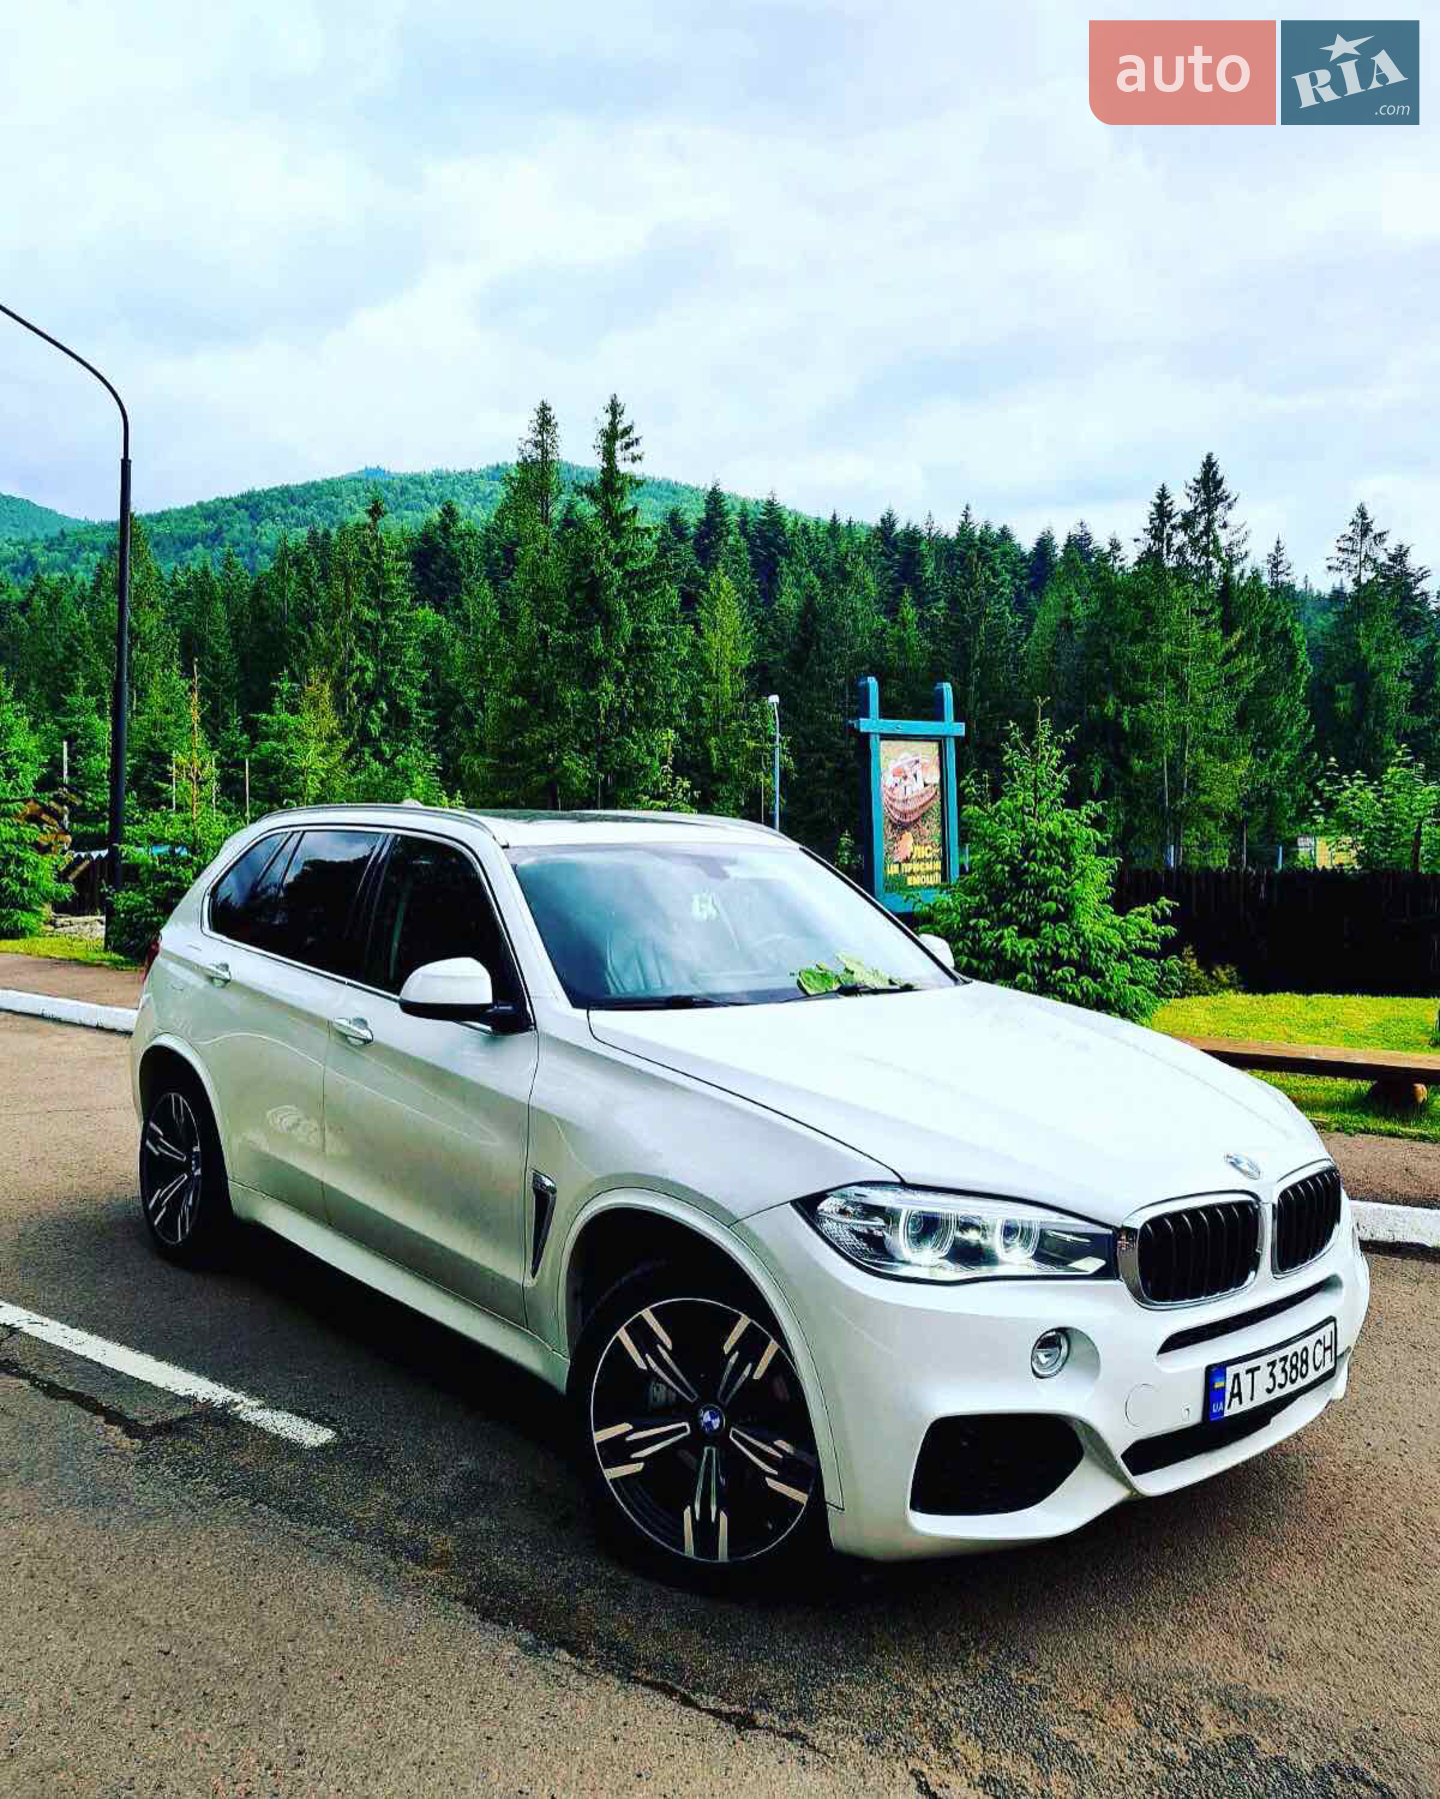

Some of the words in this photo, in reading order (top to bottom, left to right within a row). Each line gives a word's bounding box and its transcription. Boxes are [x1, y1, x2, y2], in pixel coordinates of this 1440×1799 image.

[1227, 1365, 1261, 1410] AT
[1265, 1346, 1309, 1394] 3388
[1312, 1331, 1334, 1372] CH
[1212, 1403, 1224, 1413] UA
